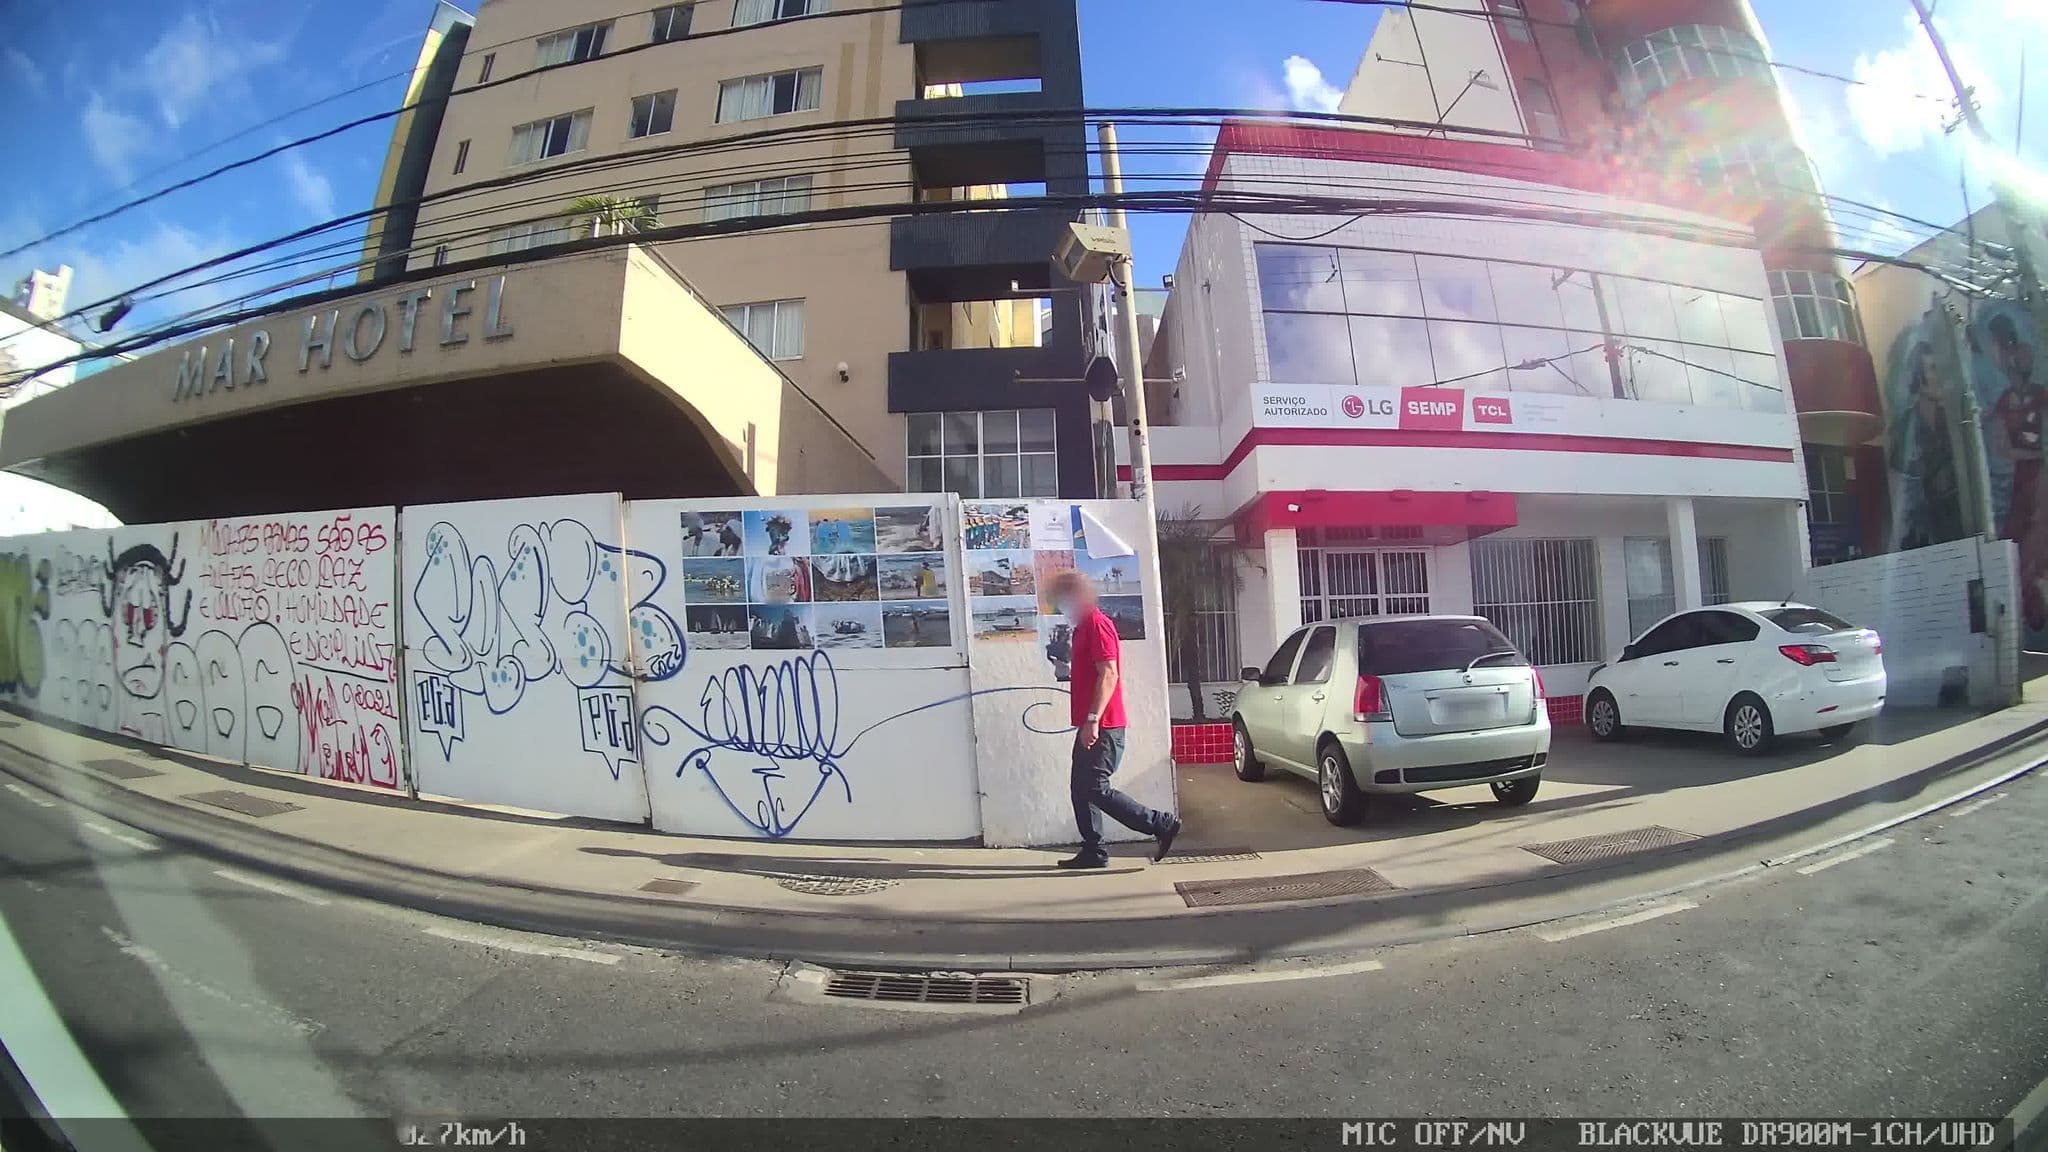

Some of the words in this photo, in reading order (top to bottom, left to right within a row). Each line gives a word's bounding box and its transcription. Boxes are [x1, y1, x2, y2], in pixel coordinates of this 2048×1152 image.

[174, 330, 270, 401] MAR
[299, 276, 513, 373] HOTEL
[1263, 396, 1306, 407] SERVIÇO
[1368, 399, 1394, 416] LG
[1407, 401, 1457, 416] SEMP
[1264, 407, 1328, 416] AUTORIZADO
[1478, 405, 1507, 417] TCL
[316, 554, 368, 592] PAZ
